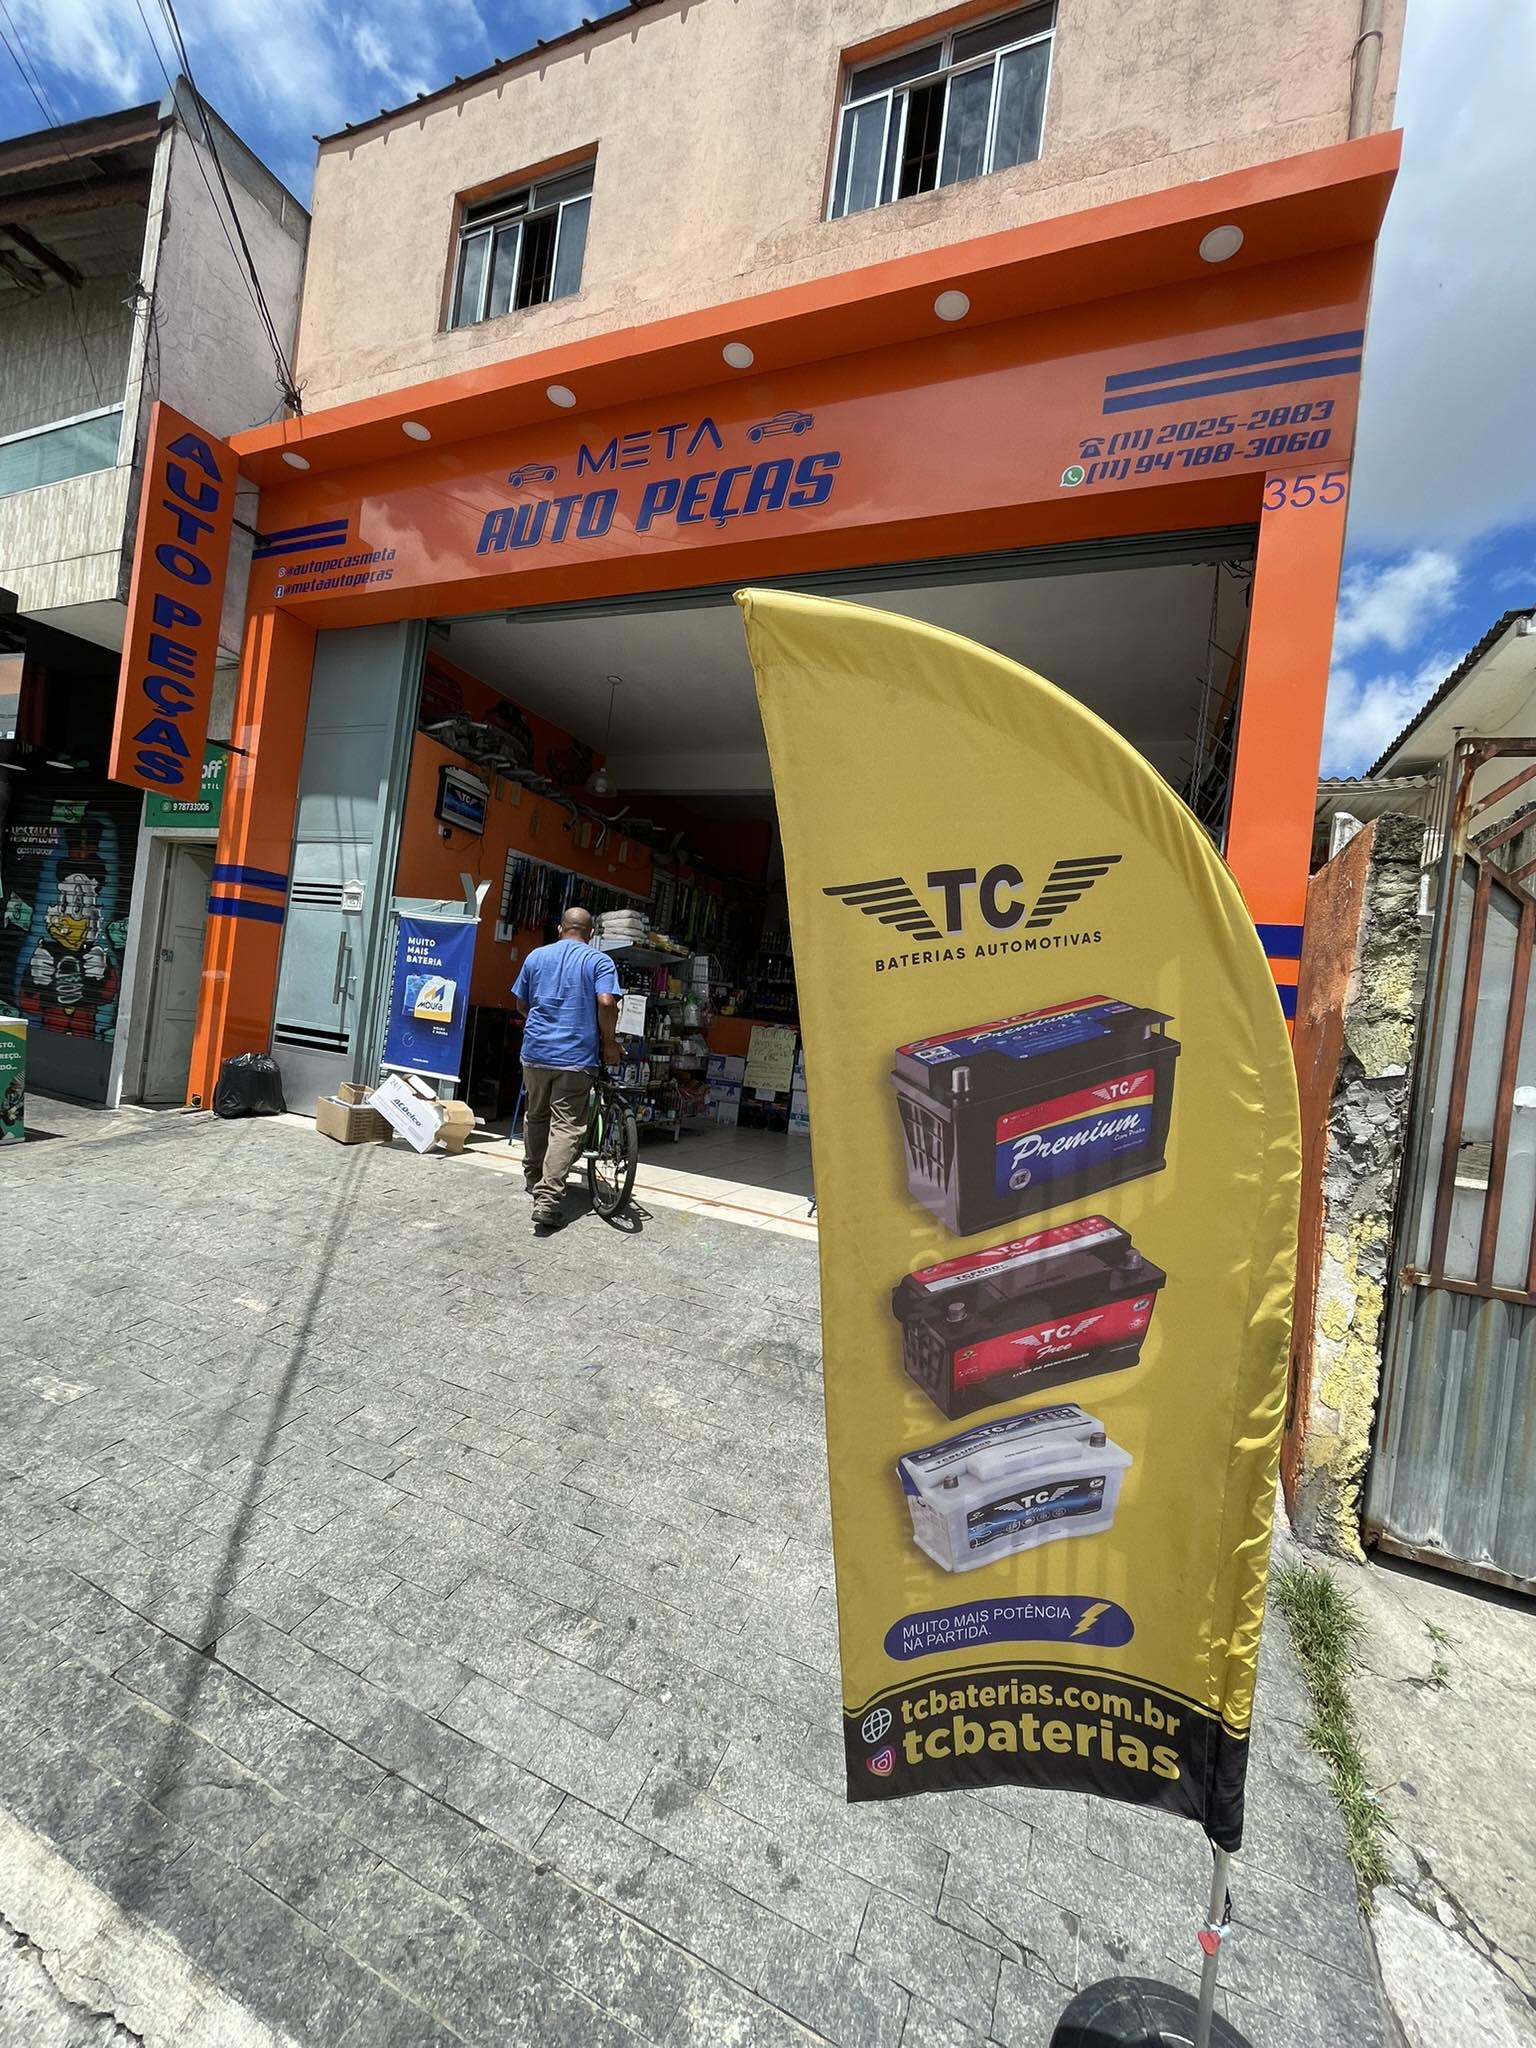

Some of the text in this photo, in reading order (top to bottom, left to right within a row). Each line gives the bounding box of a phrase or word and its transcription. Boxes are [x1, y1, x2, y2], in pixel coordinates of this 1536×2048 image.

[576, 416, 724, 478] META
[1107, 400, 1335, 455] (11) 2025-2883
[1086, 428, 1332, 485] (11) 94788-3060
[475, 451, 842, 556] AUTO PEÇAS
[1263, 470, 1346, 511] 355
[132, 432, 223, 786] AUTO PEÇAS
[926, 864, 1026, 933] TC
[406, 955, 442, 967] BATERIA
[407, 946, 429, 956] MAIS
[408, 936, 436, 948] MUITO
[875, 931, 1103, 973] BATERIAS AUTOMOTIVAS
[967, 1012, 1078, 1044] Premium
[1109, 1081, 1129, 1098] TC
[1011, 1113, 1142, 1170] Premium
[1036, 1342, 1073, 1359] Free
[1040, 1324, 1072, 1343] TC
[1021, 1491, 1049, 1508] TC
[903, 1603, 1071, 1640] MUITO MAIS POTÊNCIA
[903, 1628, 992, 1654] NA PARTIDA.
[901, 1678, 1181, 1737] tcbaterias.com.br
[902, 1713, 1181, 1781] tcbaterias
